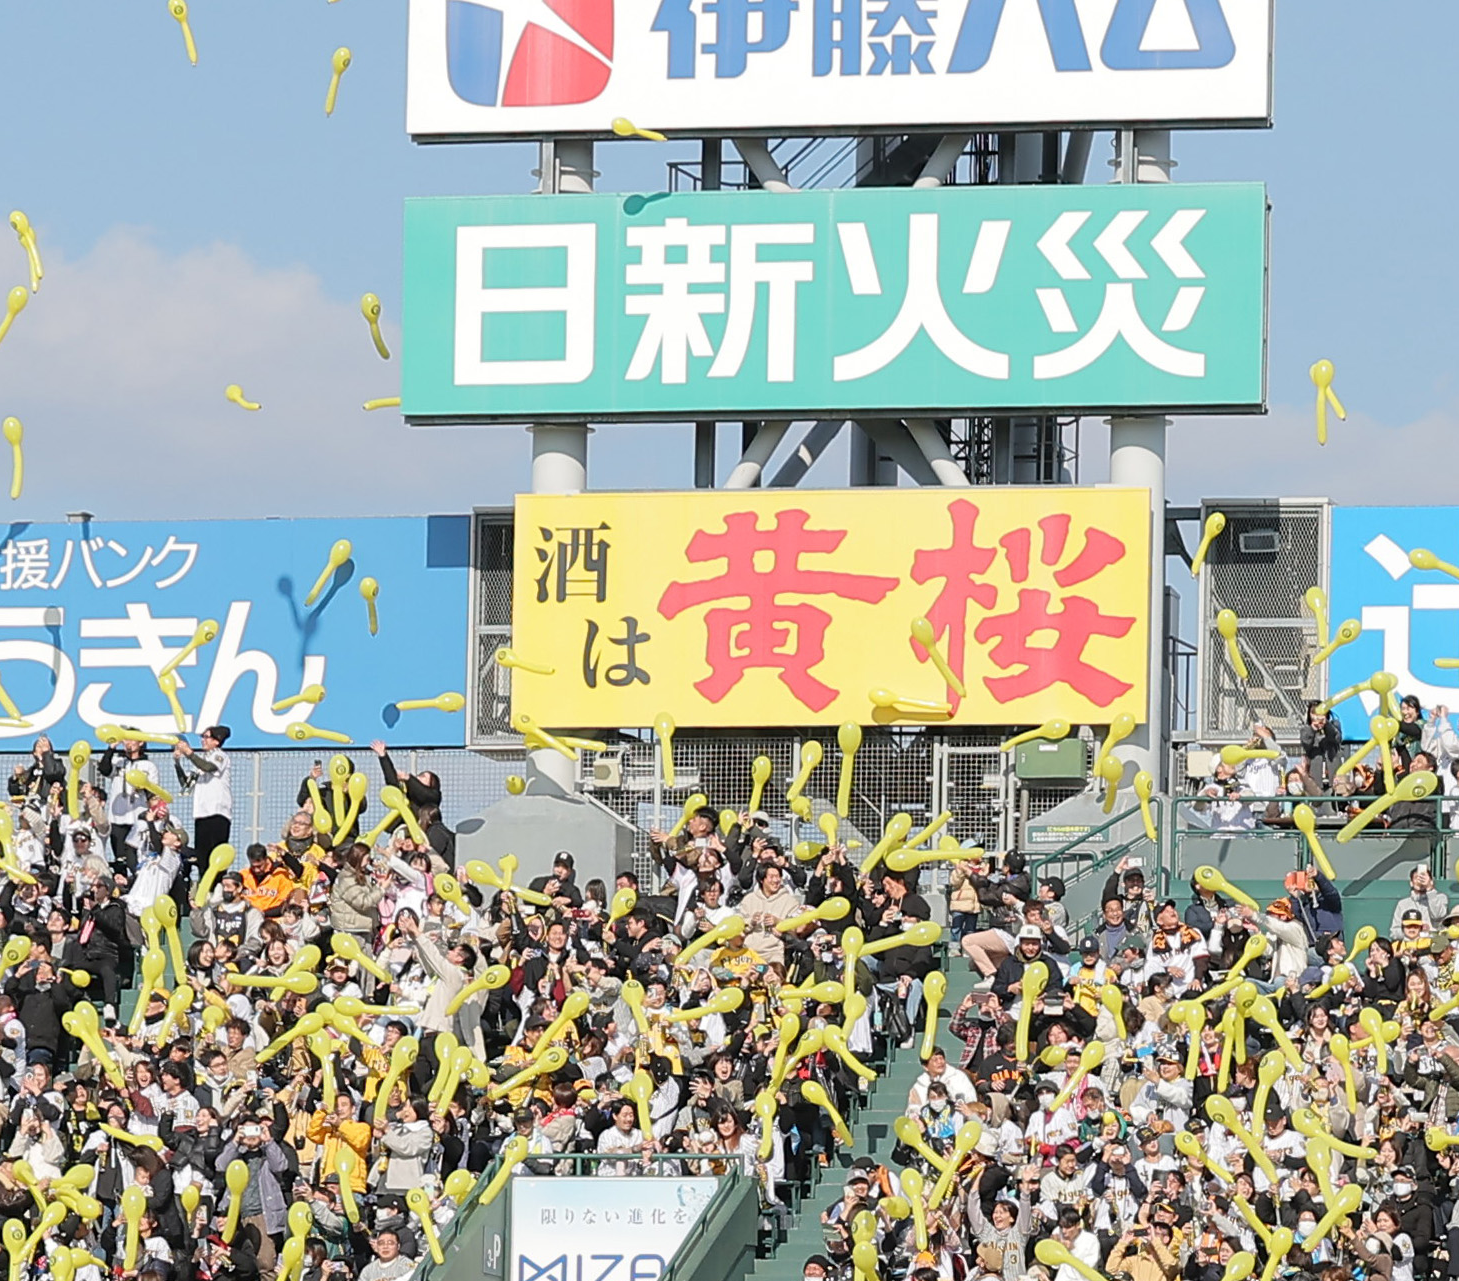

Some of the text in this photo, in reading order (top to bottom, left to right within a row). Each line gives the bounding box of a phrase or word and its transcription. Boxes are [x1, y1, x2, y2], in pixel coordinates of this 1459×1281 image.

[453, 208, 1208, 387] 日新火災
[531, 521, 652, 690] 酒は
[656, 497, 1138, 718] 黄桜
[540, 1208, 689, 1226] 限りない進化を
[1009, 1253, 1018, 1265] 3
